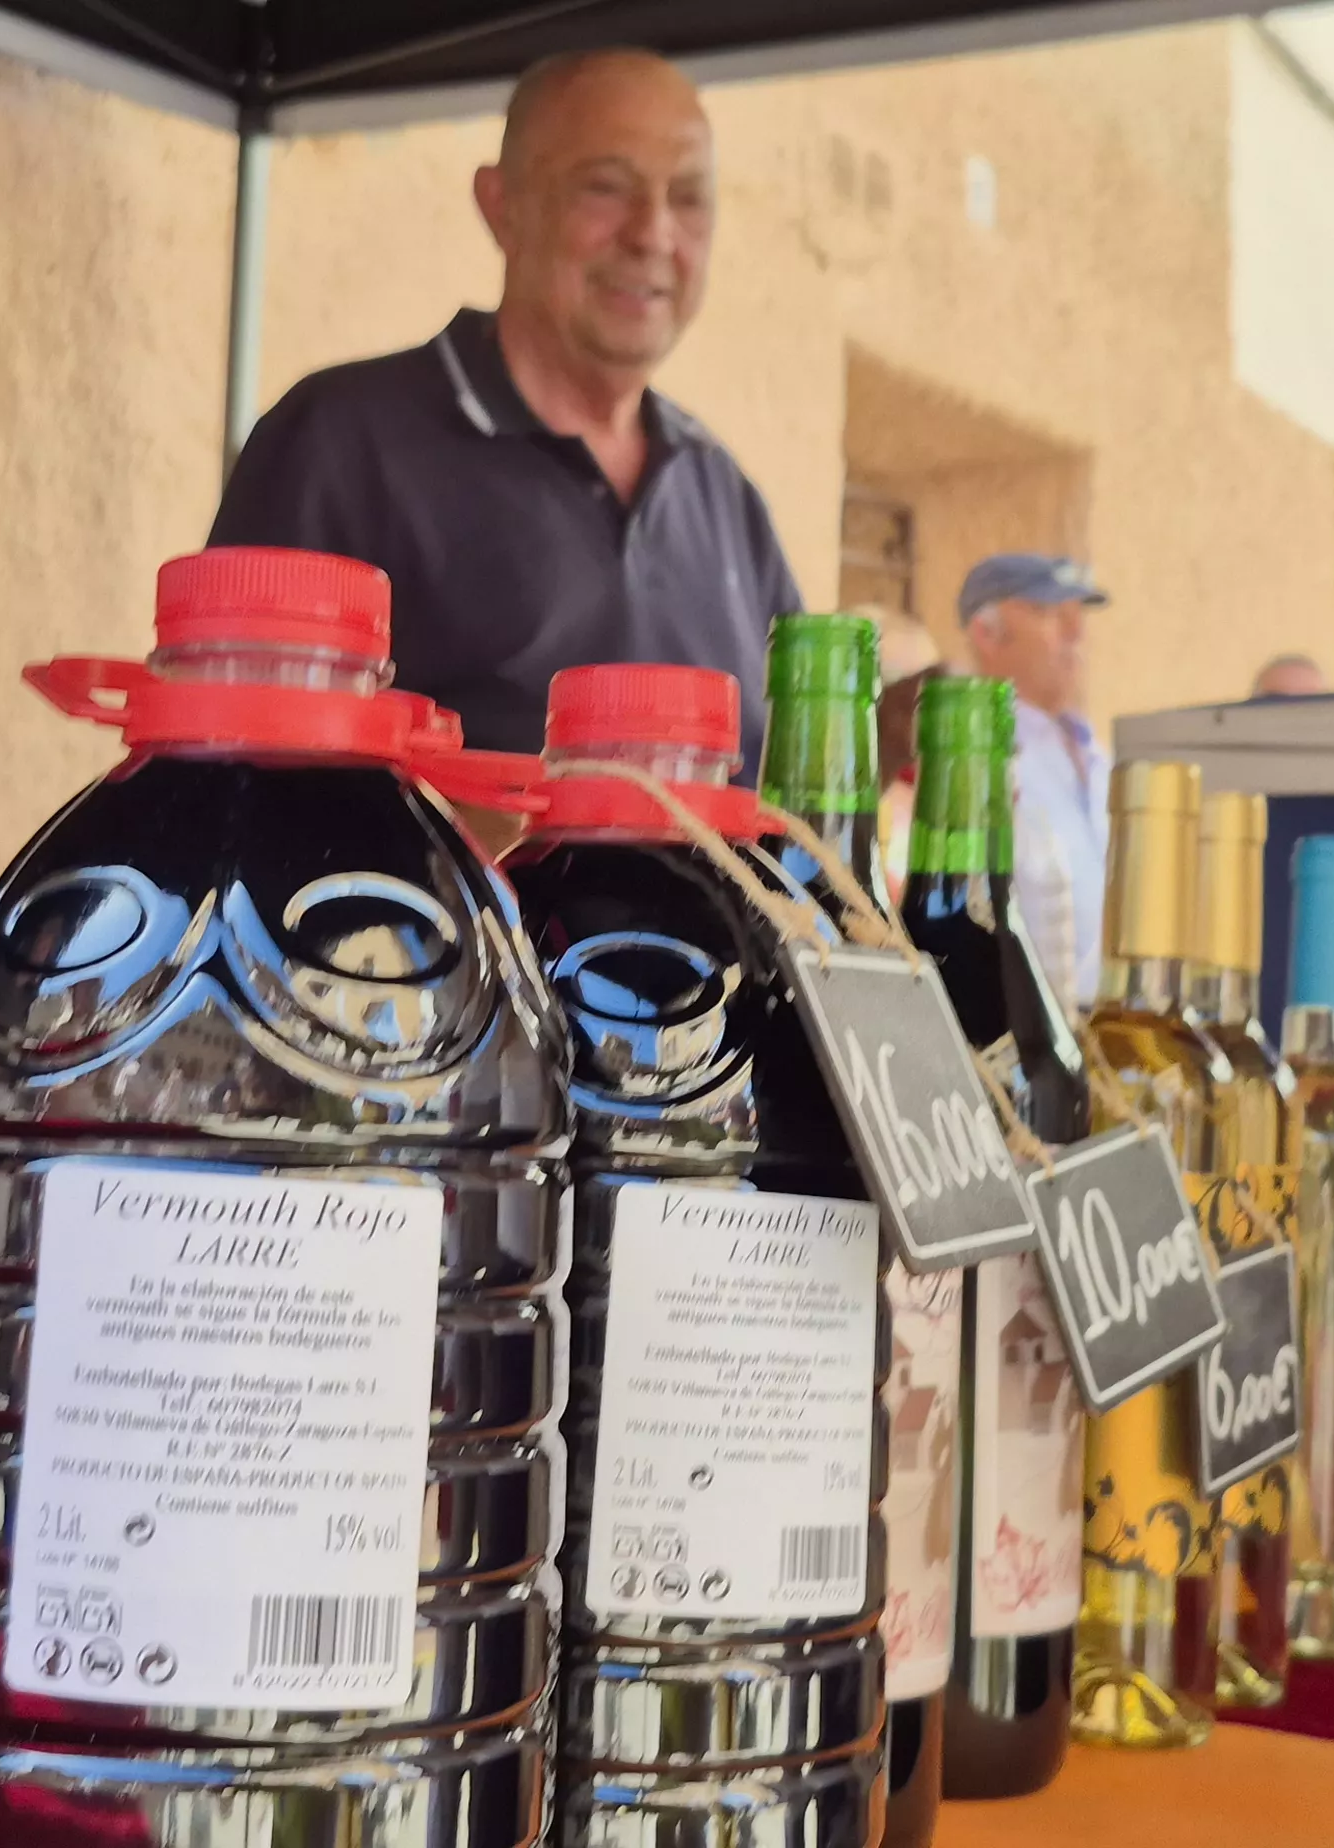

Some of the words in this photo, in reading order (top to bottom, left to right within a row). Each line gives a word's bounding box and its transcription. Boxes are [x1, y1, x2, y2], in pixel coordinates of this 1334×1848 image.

[91, 1177, 299, 1230] Vermouth
[312, 1193, 408, 1245] Rojo
[660, 1193, 810, 1235] Vermouth
[816, 1205, 867, 1246] Rojo
[173, 1232, 304, 1270] LARRE
[727, 1239, 811, 1268] LARRE
[1058, 1187, 1201, 1343] 10,00€
[129, 1272, 155, 1297] En
[159, 1274, 177, 1298] la
[293, 1283, 317, 1305] de
[85, 1296, 169, 1318] vermouth
[174, 1303, 195, 1320] se
[253, 1301, 271, 1324] la
[351, 1306, 373, 1328] de
[99, 1319, 177, 1346] antiguos
[73, 1362, 187, 1391] Embotellado
[1208, 1341, 1299, 1445] 6,00€
[37, 1500, 51, 1539] 2
[154, 1492, 232, 1516] Contiene
[325, 1512, 369, 1555] 15%
